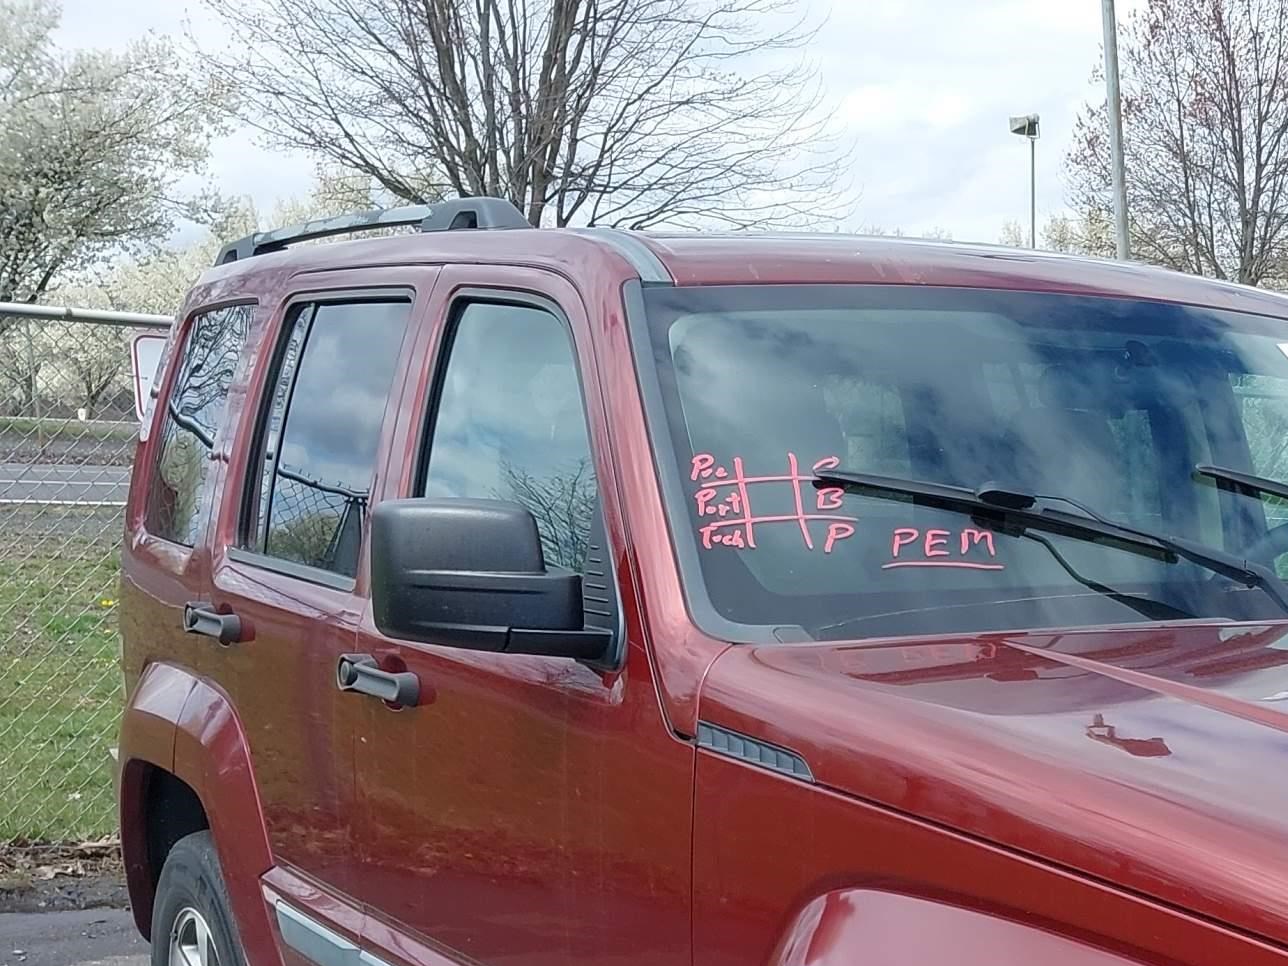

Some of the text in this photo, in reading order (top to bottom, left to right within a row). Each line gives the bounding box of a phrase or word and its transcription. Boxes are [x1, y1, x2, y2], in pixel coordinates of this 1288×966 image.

[694, 488, 742, 517] Port
[816, 487, 845, 509] B
[824, 523, 855, 553] P
[892, 528, 997, 557] PEM
